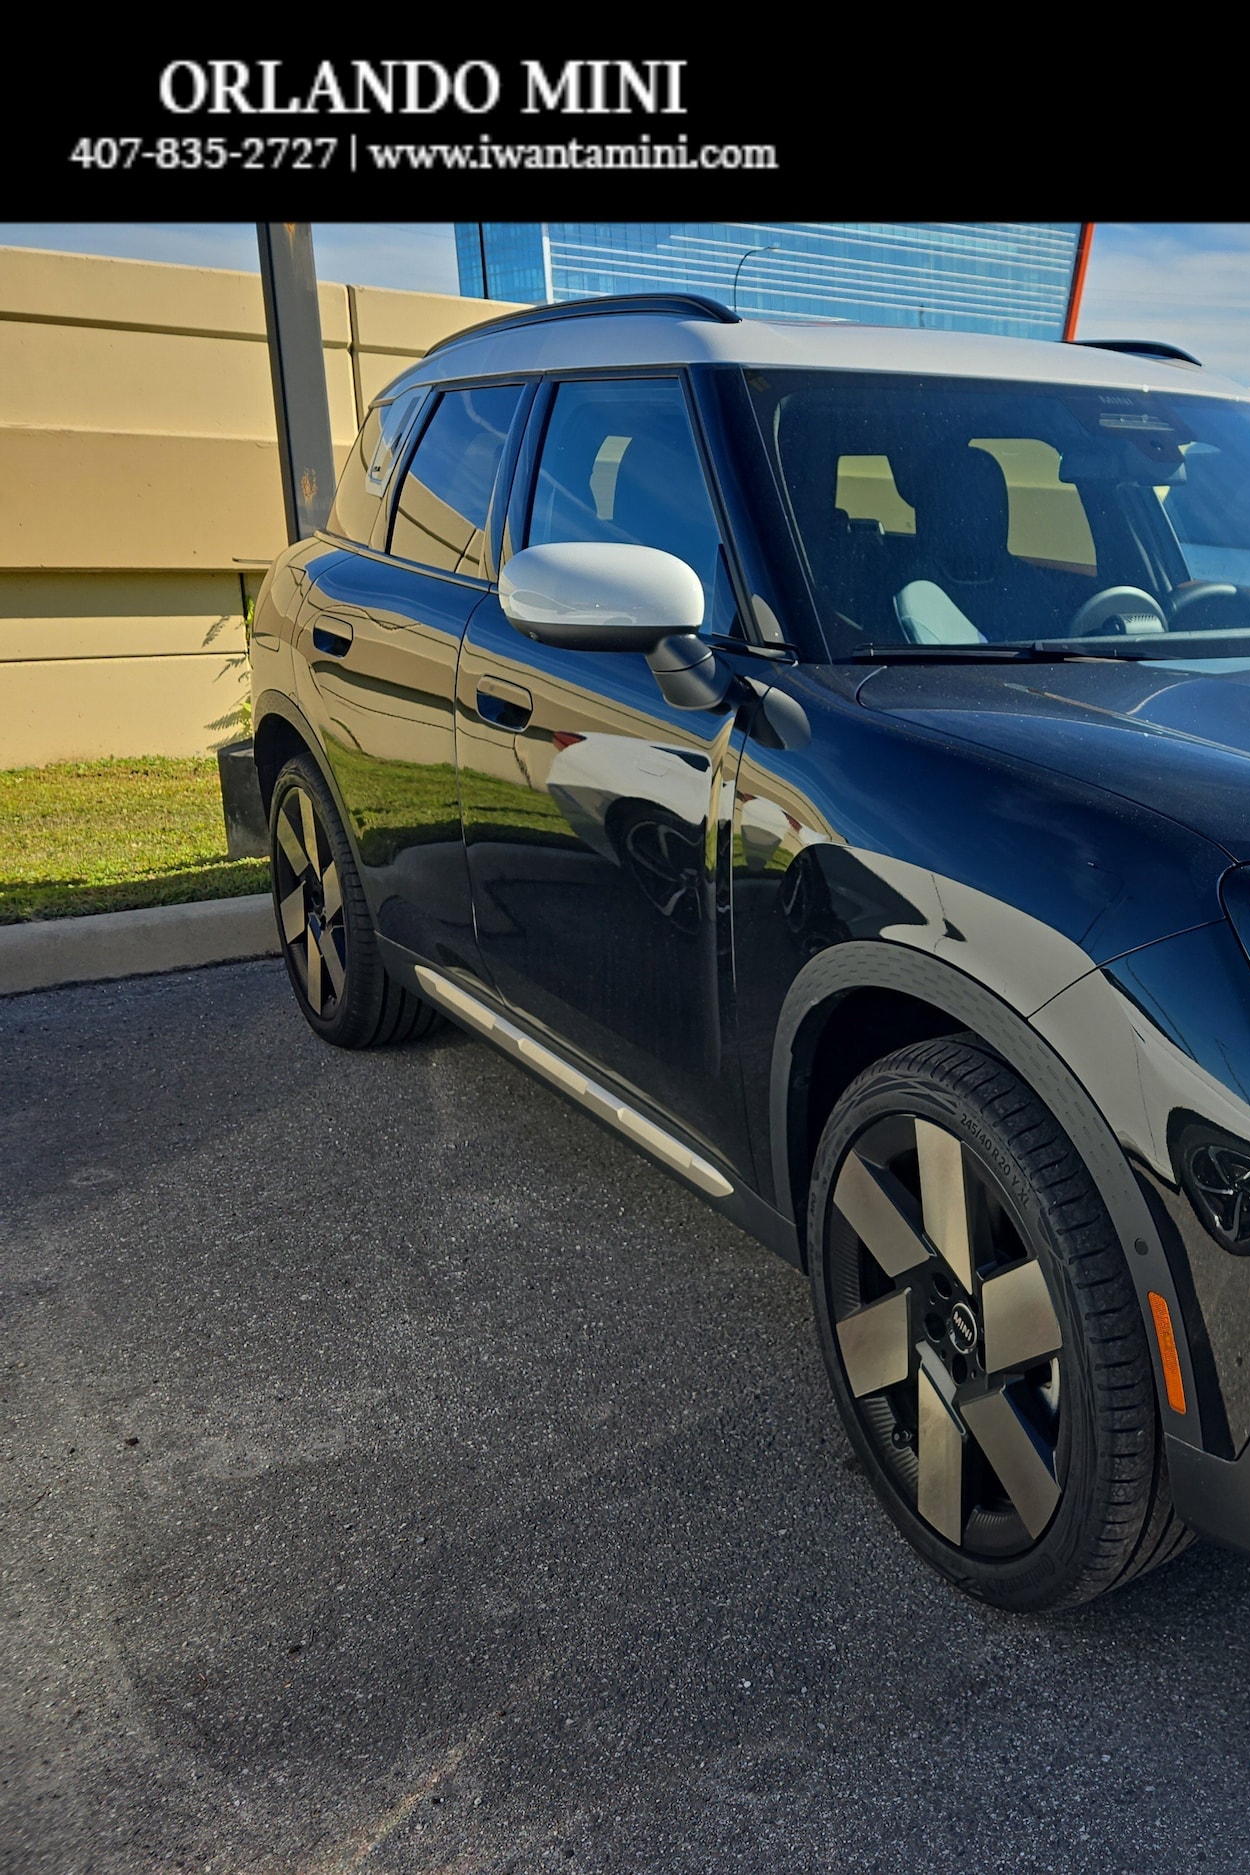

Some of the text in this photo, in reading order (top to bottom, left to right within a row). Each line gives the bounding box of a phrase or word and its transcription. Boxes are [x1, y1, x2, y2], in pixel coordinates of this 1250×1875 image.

[960, 1113, 1030, 1210] 245/40 R 20 Y XL
[953, 1311, 973, 1341] MINI
